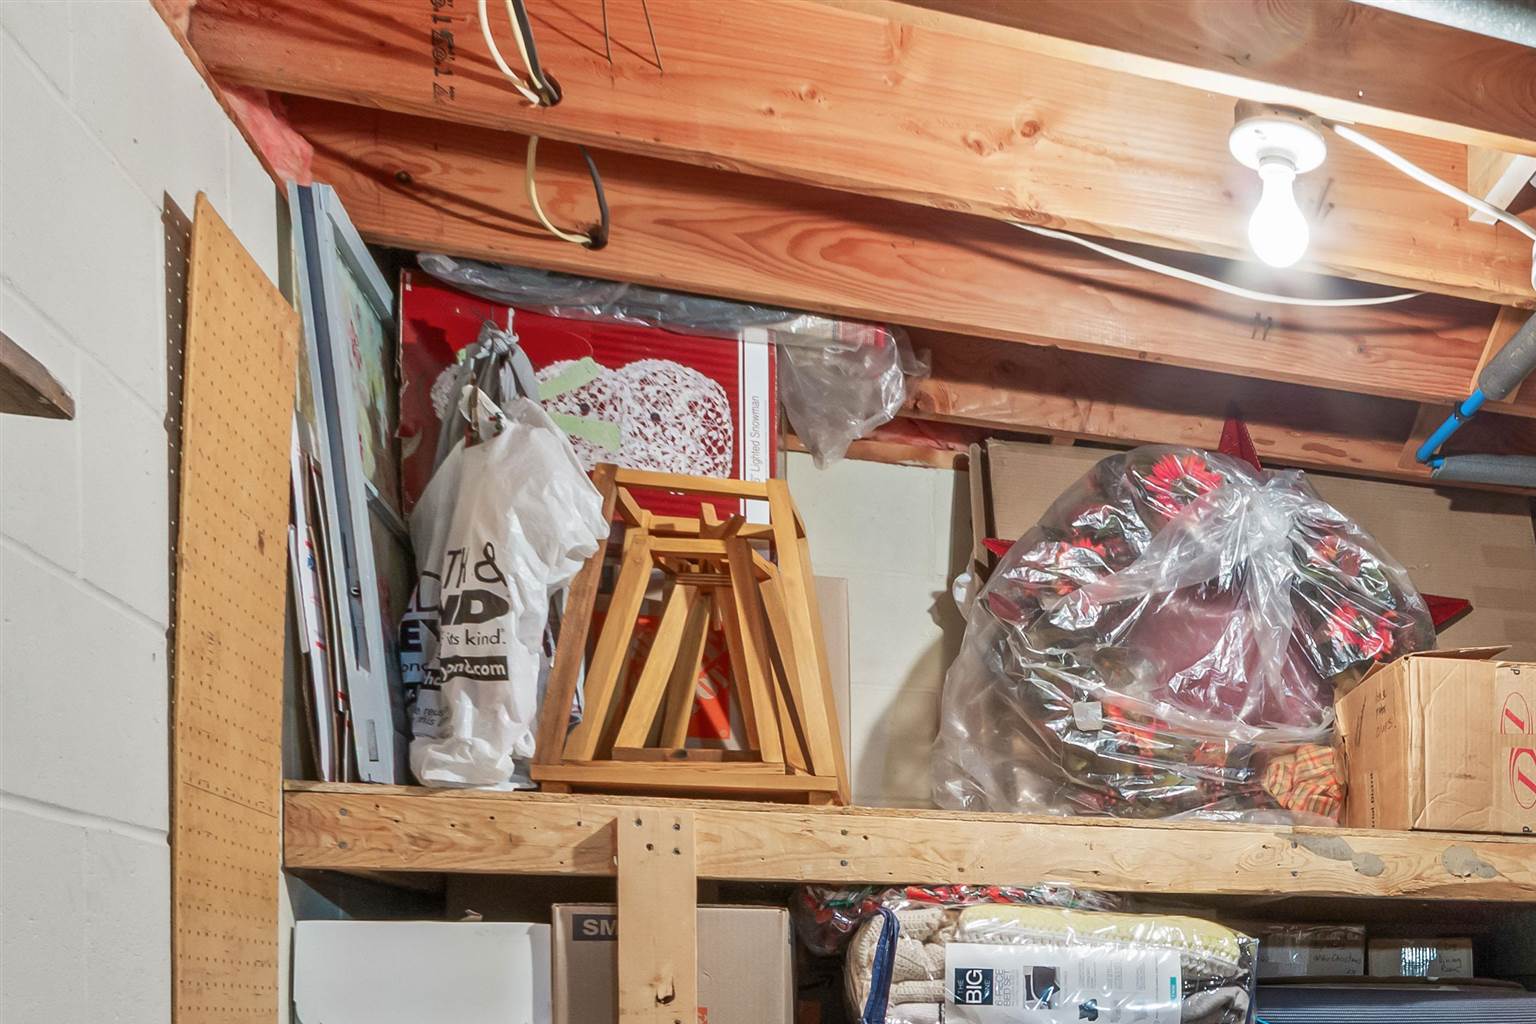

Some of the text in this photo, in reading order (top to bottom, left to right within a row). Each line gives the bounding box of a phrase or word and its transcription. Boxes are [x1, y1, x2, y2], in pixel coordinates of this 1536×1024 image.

[750, 395, 761, 437] Snowman
[751, 438, 763, 477] Lighted
[966, 969, 983, 1004] BIG
